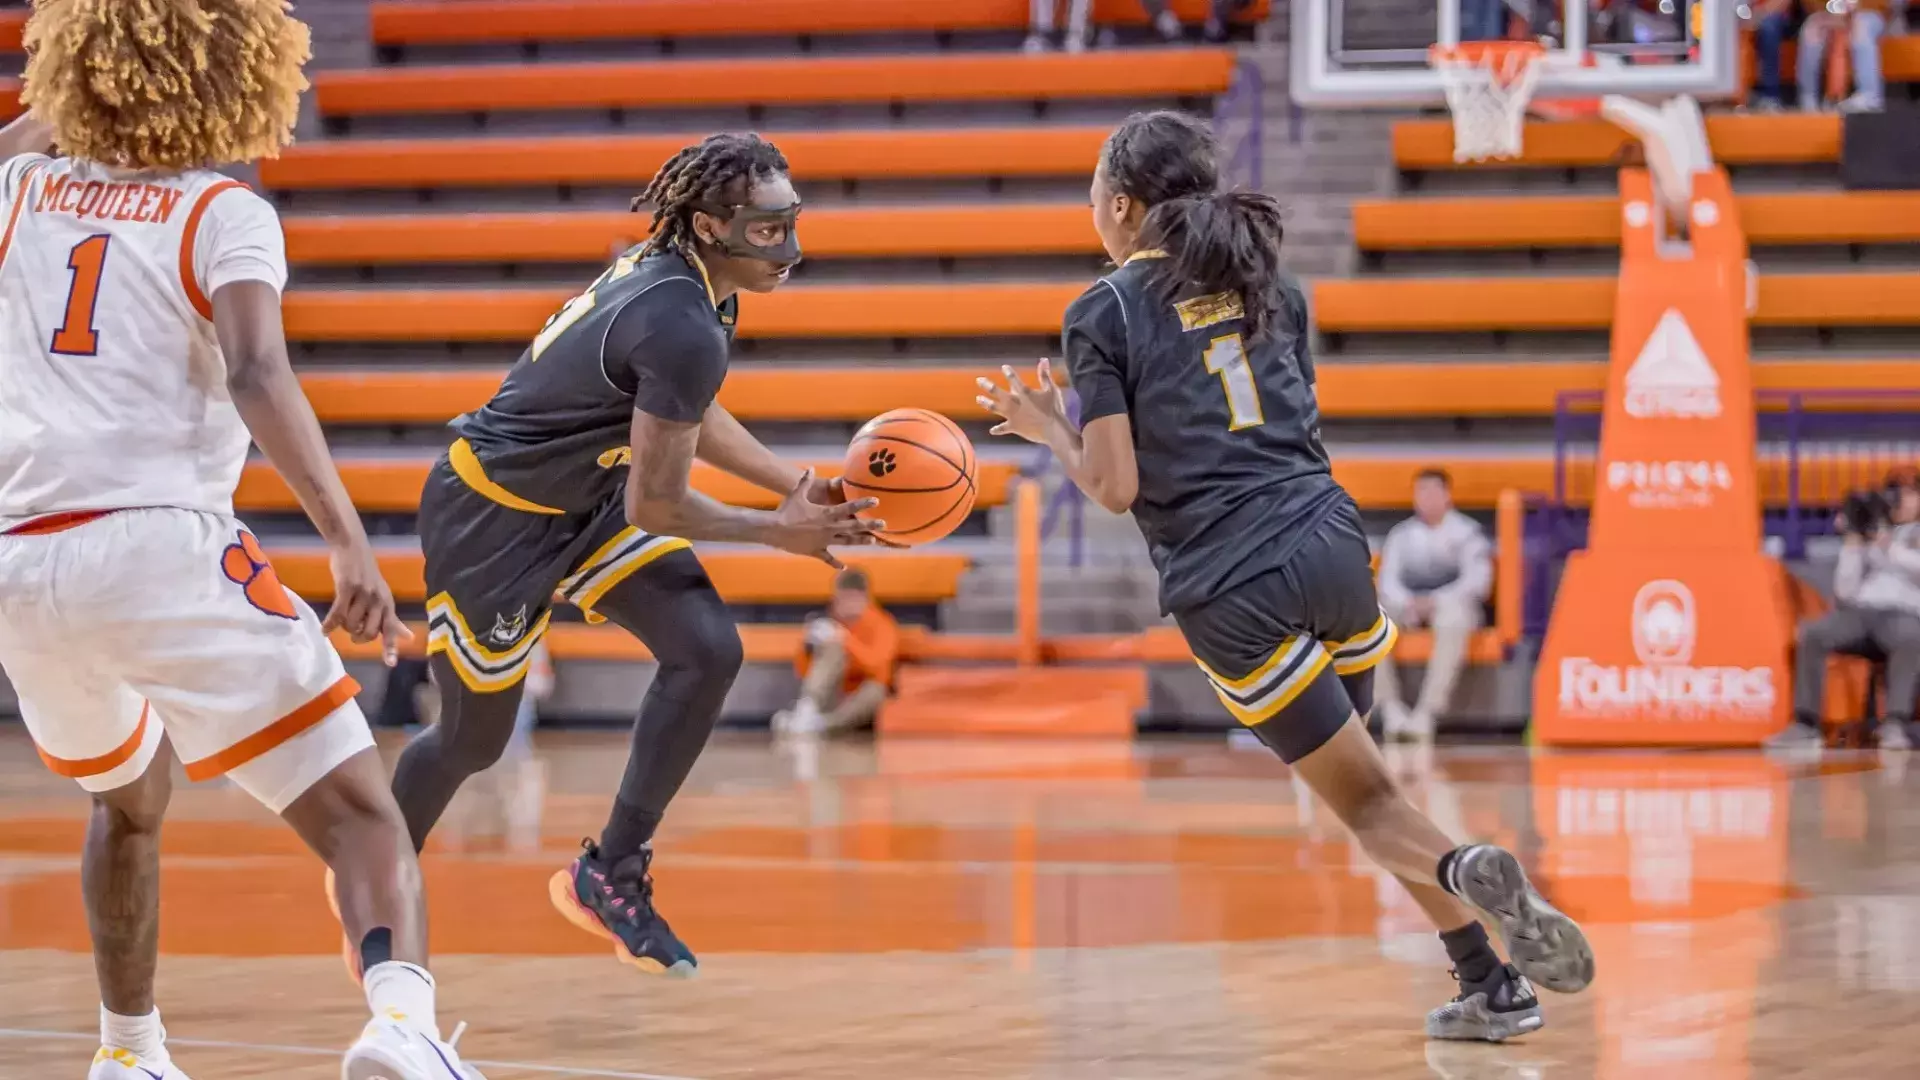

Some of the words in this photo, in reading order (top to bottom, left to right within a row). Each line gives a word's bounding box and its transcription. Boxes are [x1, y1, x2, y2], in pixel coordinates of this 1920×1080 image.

[50, 233, 111, 356] 1
[1203, 332, 1265, 431] 1
[1558, 656, 1776, 711] FOUNDERS
